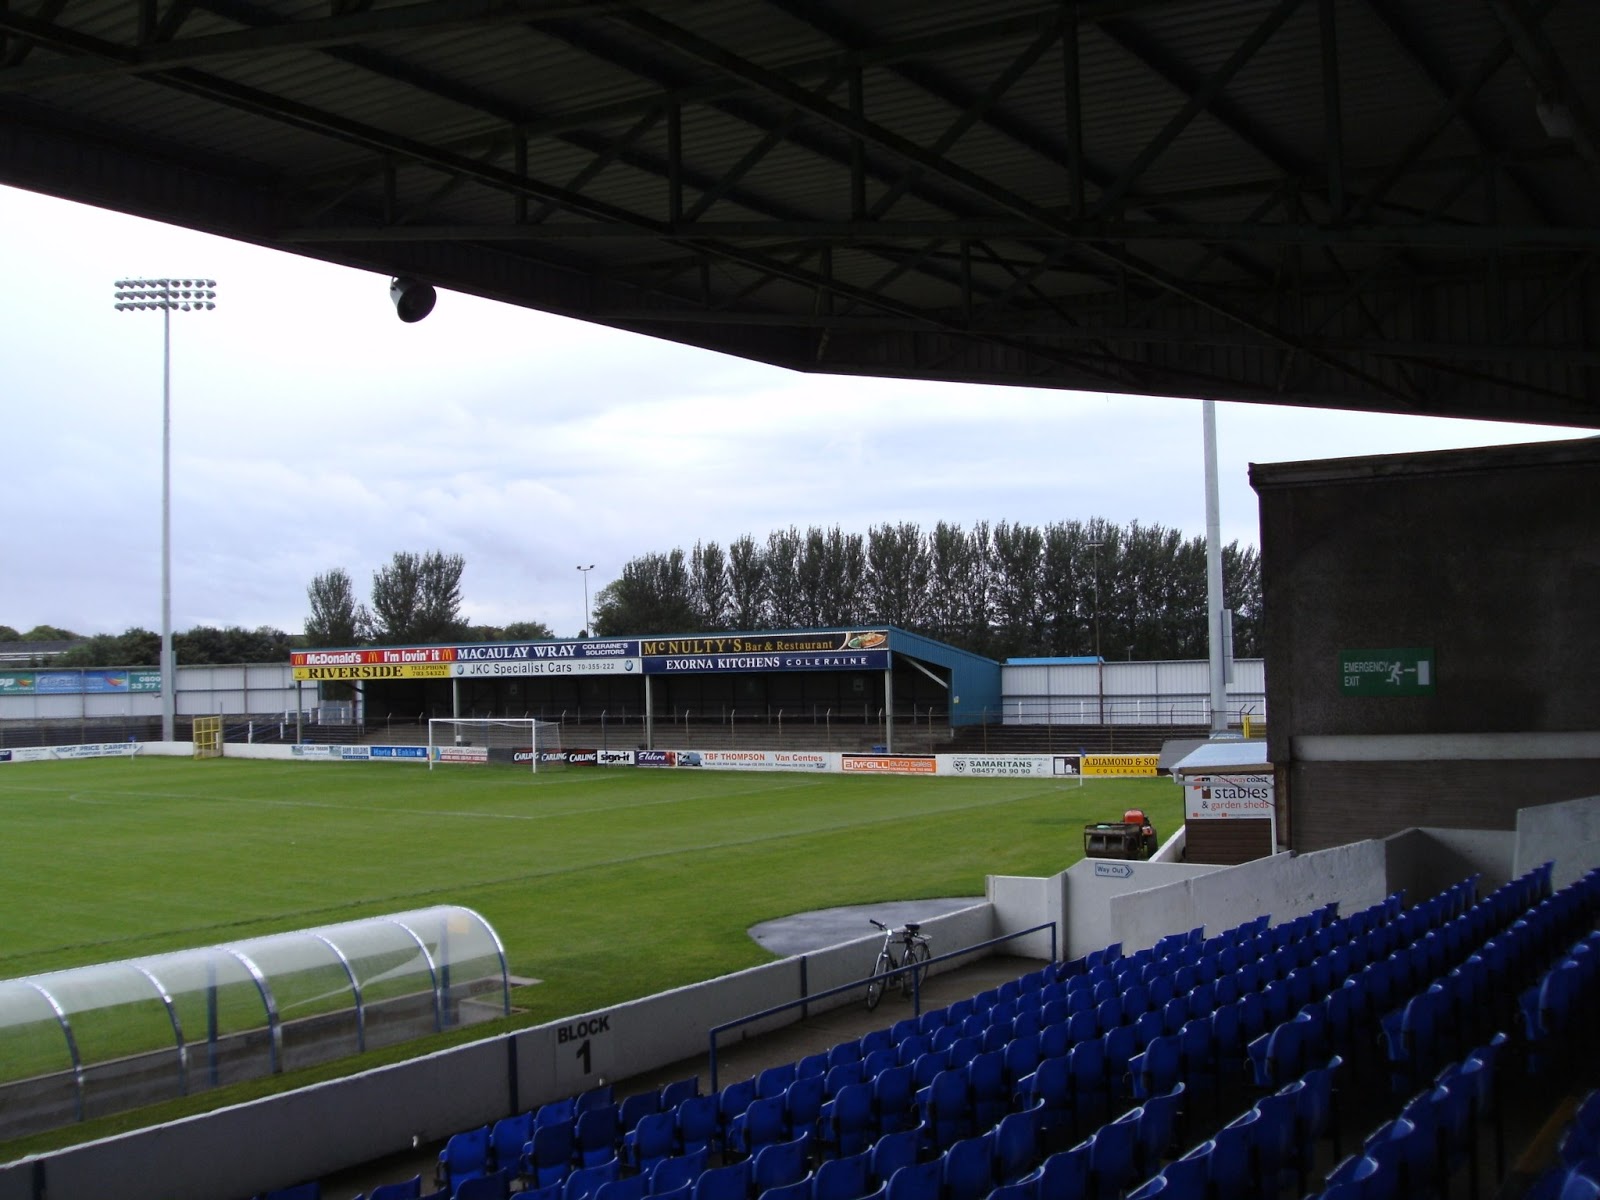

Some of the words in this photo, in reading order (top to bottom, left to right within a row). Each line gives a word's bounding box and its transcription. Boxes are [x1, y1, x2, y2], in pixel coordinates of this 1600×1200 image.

[582, 642, 628, 650] COLERAINE'S
[745, 642, 762, 651] Bar
[764, 641, 773, 651] &
[776, 640, 833, 650] Restaurant
[306, 653, 361, 664] McDonald's
[383, 651, 399, 662] I'm
[401, 649, 429, 662] lovin'
[431, 649, 440, 661] it
[457, 646, 529, 660] MACAULAY
[533, 644, 577, 657] WRAY
[470, 663, 490, 675] JKC
[494, 662, 544, 675] Specialist
[548, 661, 572, 673] Cars
[665, 659, 714, 670] EXORNA
[717, 657, 780, 669] KITCHENS
[786, 657, 868, 666] COLERAINE
[1344, 661, 1388, 673] EMERGENCY
[308, 665, 403, 679] RIVERSIDE
[1344, 676, 1360, 687] EXIT
[391, 748, 397, 757] &
[541, 752, 567, 761] CARLING
[569, 753, 596, 762] CARLING
[600, 751, 630, 762] sign-it
[638, 751, 665, 760] Elders
[792, 753, 823, 761] Centres
[969, 760, 1032, 768] SAMARITANS
[1135, 758, 1142, 766] &
[1214, 787, 1268, 799] stables
[1201, 801, 1209, 809] &
[1211, 800, 1241, 811] garden
[1243, 799, 1269, 809] sheds
[1096, 866, 1110, 874] Way
[557, 1014, 610, 1045] BLOCK
[576, 1039, 591, 1075] 1
